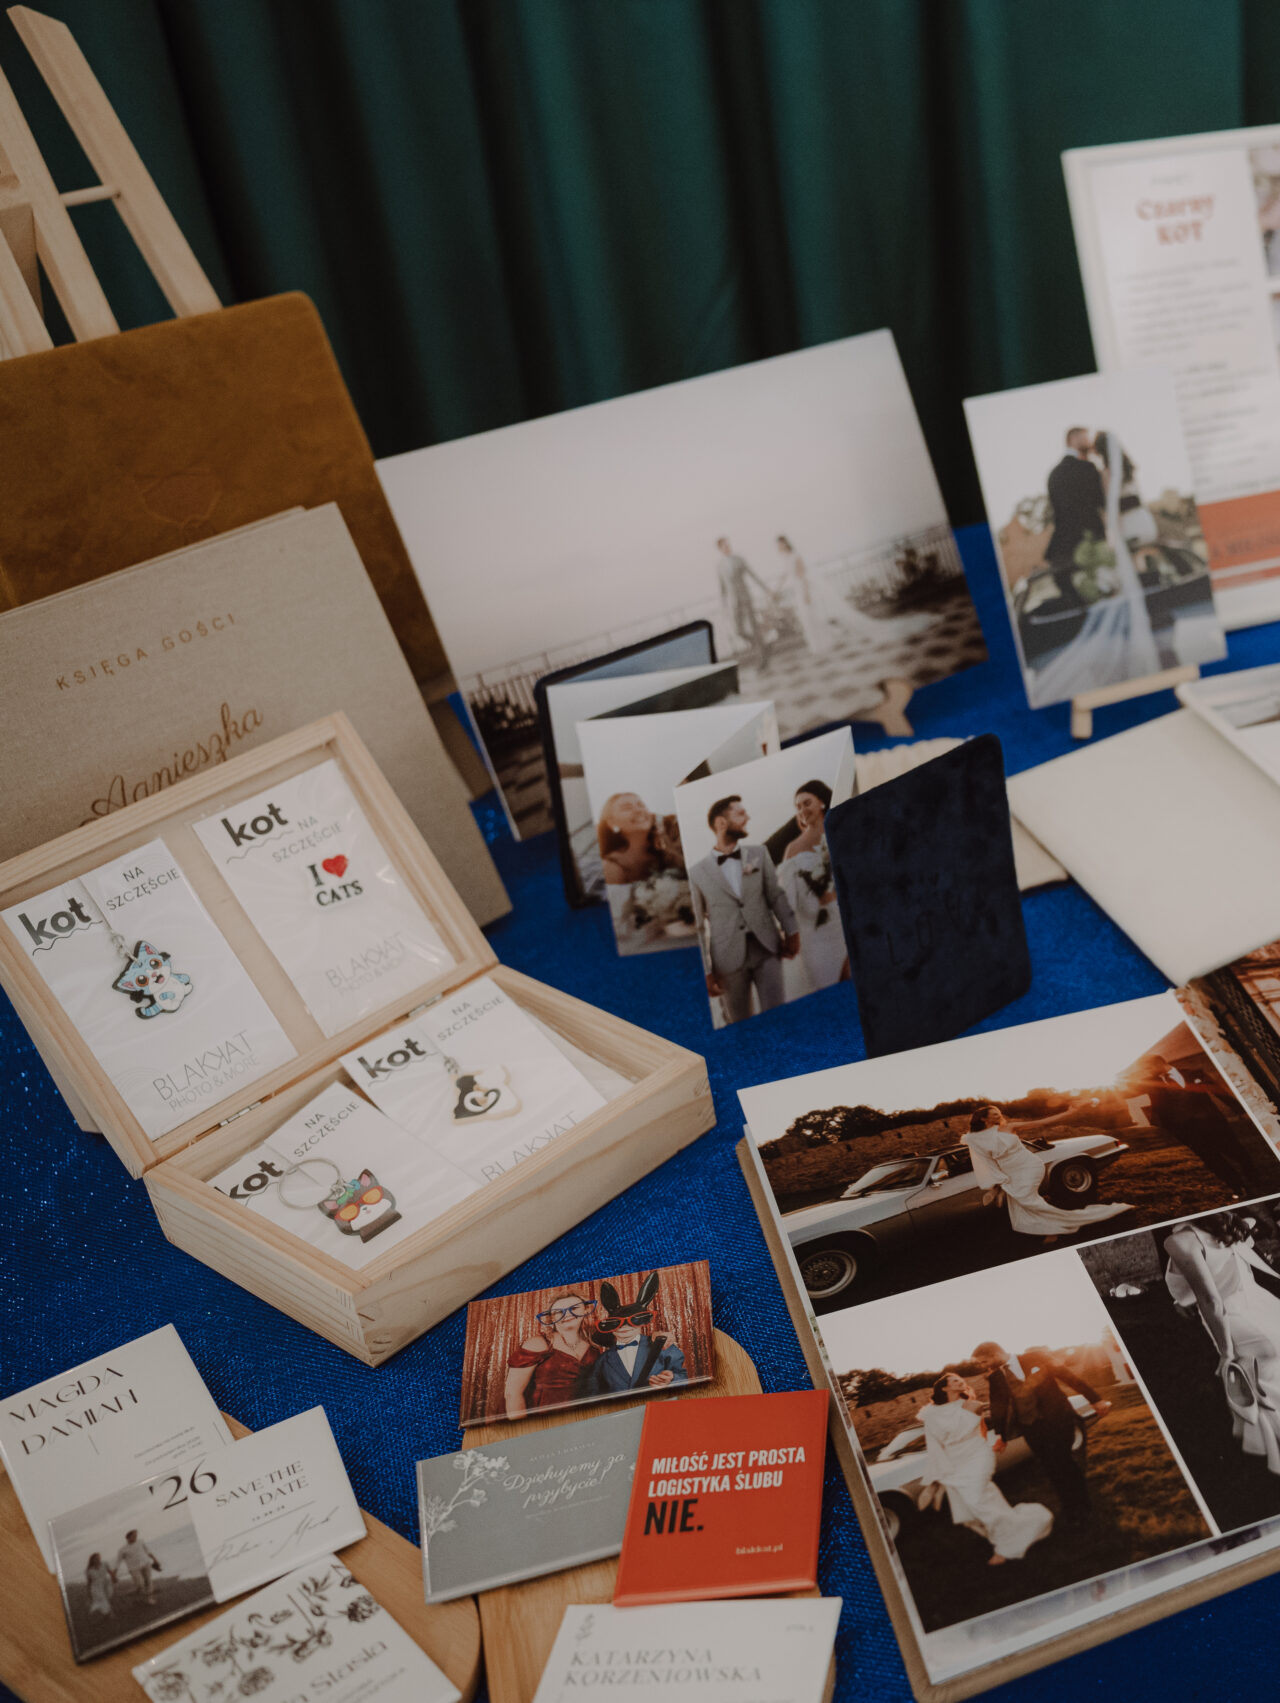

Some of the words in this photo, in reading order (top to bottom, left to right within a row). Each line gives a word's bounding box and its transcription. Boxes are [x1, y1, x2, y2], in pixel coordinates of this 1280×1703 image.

[56, 647, 149, 691] KSIĘGA
[161, 613, 236, 651] GOŚCI
[221, 803, 289, 847] kot
[297, 816, 318, 831] NA
[272, 822, 343, 863] SZCZĘŚCIE
[106, 868, 180, 911] SZCZĘŚCIE
[123, 866, 145, 882] NA
[307, 864, 325, 887] I
[316, 880, 363, 906] CATS
[18, 897, 91, 945] kot
[437, 997, 505, 1041] SZCZĘŚCIE
[452, 1001, 472, 1016] NA
[357, 1038, 427, 1079] kot
[168, 1080, 213, 1112] PHOTO
[294, 1102, 360, 1158] SZCZĘŚCIE
[304, 1113, 326, 1129] NA
[9, 1367, 124, 1424] MAGDA
[21, 1389, 138, 1456] DAMIAN
[604, 1453, 626, 1473] za
[651, 1451, 710, 1475] MIŁOŚĆ
[711, 1451, 746, 1470] JEST
[748, 1446, 806, 1467] PROSTA
[216, 1477, 264, 1508] SAVE
[265, 1460, 304, 1483] THE
[259, 1475, 309, 1505] DATE
[647, 1475, 731, 1498] LOGISTYKA
[734, 1470, 784, 1491] ŚLUBU
[643, 1498, 705, 1536] NIE.
[570, 1648, 713, 1668] KATARZYNA
[563, 1667, 763, 1688] KORZENIOWSKA
